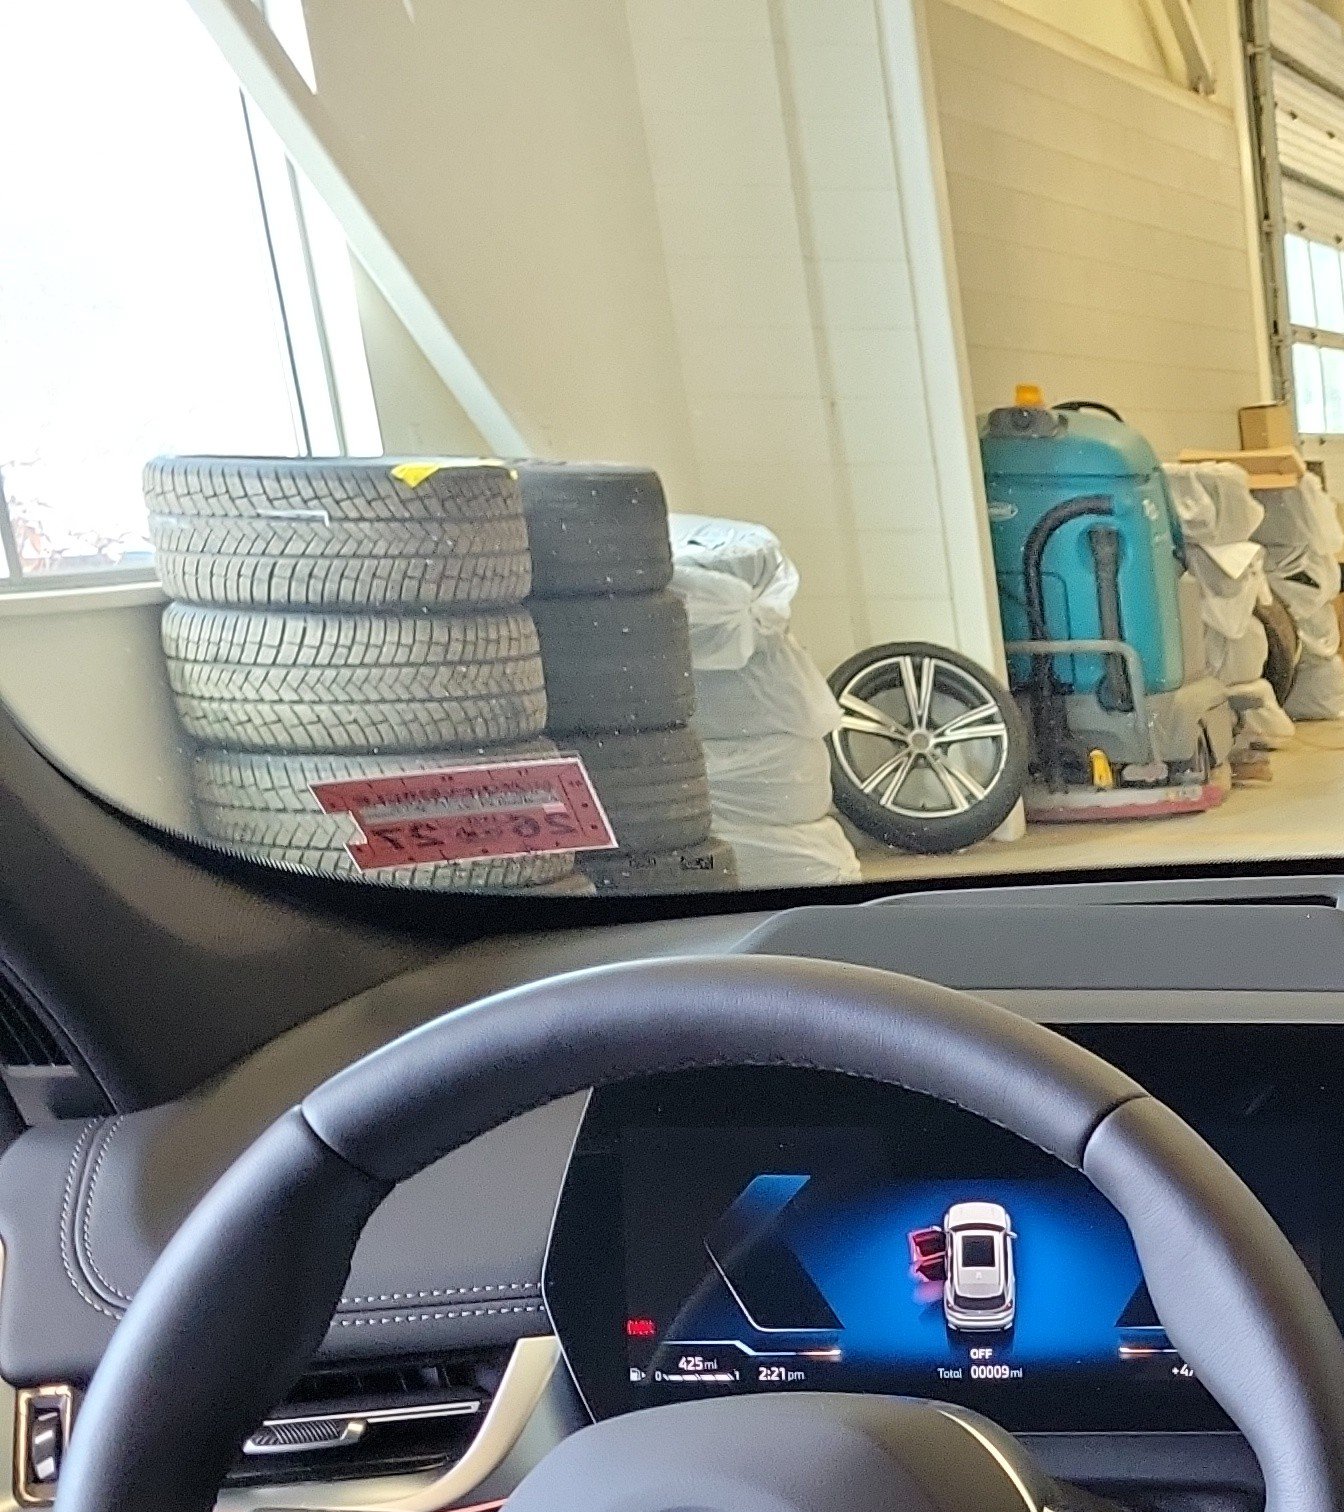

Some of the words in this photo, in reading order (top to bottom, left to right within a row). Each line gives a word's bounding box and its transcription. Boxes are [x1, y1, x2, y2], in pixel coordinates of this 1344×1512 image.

[970, 1348, 993, 1360] OFF
[678, 1356, 703, 1371] 425
[758, 1366, 786, 1381] 2:21
[788, 1371, 805, 1381] pm
[937, 1368, 962, 1379] Total
[970, 1365, 1010, 1379] 00009
